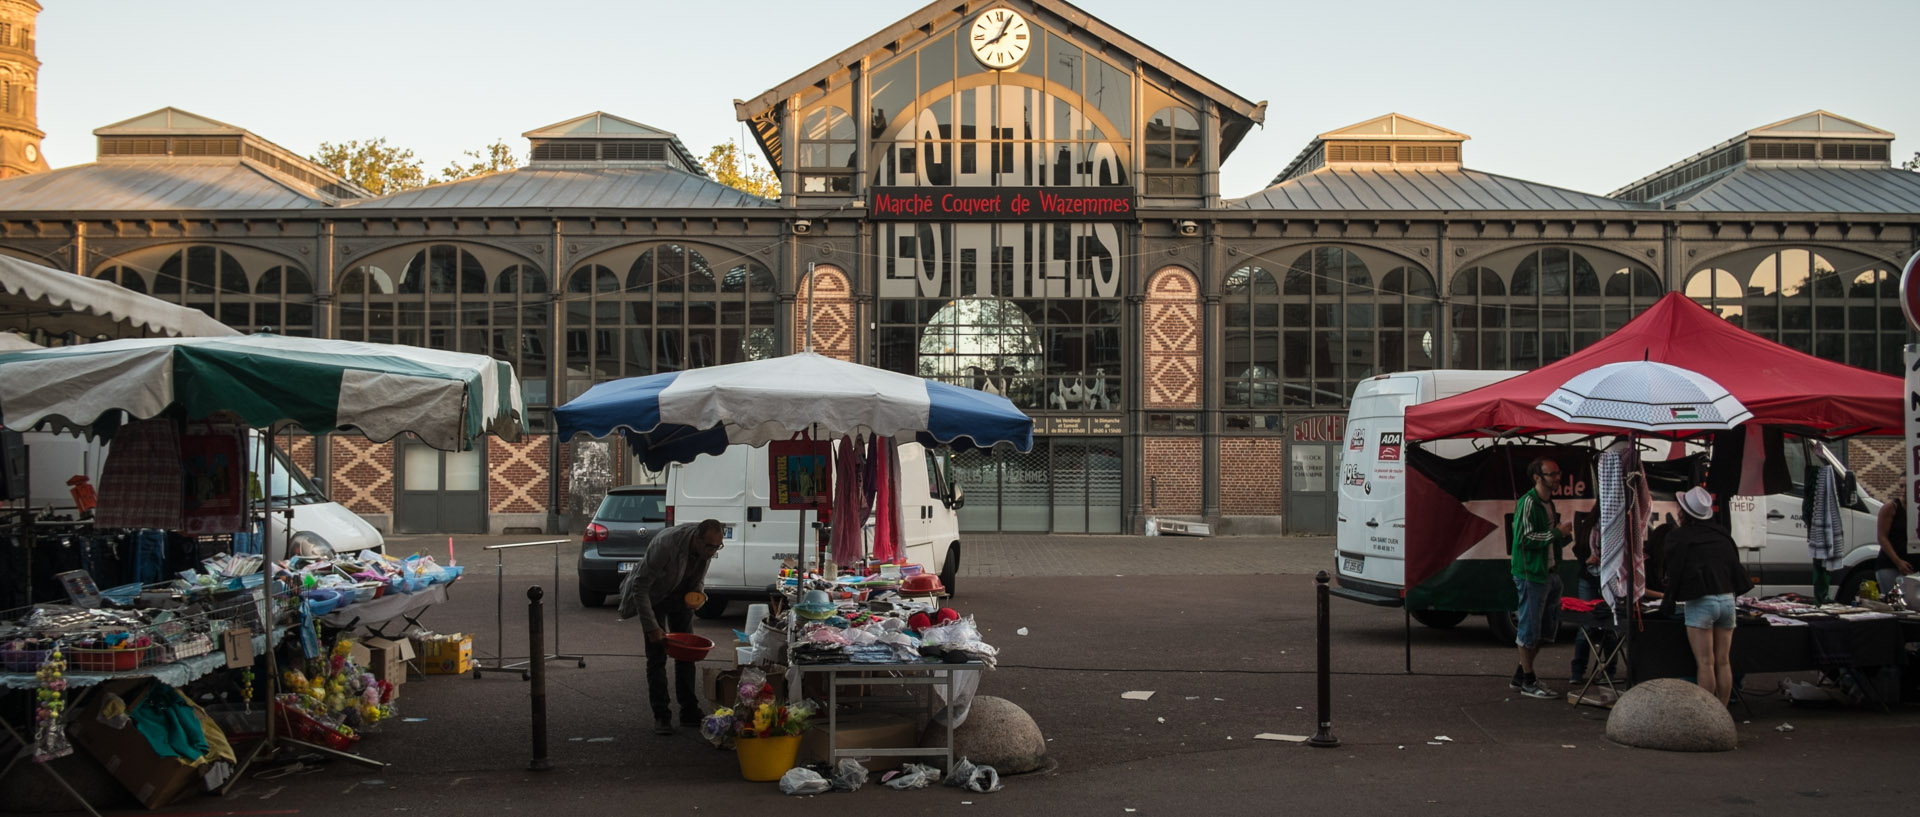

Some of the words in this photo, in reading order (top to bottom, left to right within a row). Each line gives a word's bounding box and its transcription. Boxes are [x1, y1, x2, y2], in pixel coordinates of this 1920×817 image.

[874, 193, 933, 215] Marché
[941, 193, 1001, 215] Couvert
[1010, 193, 1031, 216] de
[1039, 190, 1130, 216] Wazemmes
[1381, 433, 1401, 444] ADA
[776, 455, 788, 482] YORK
[777, 483, 789, 505] NEW
